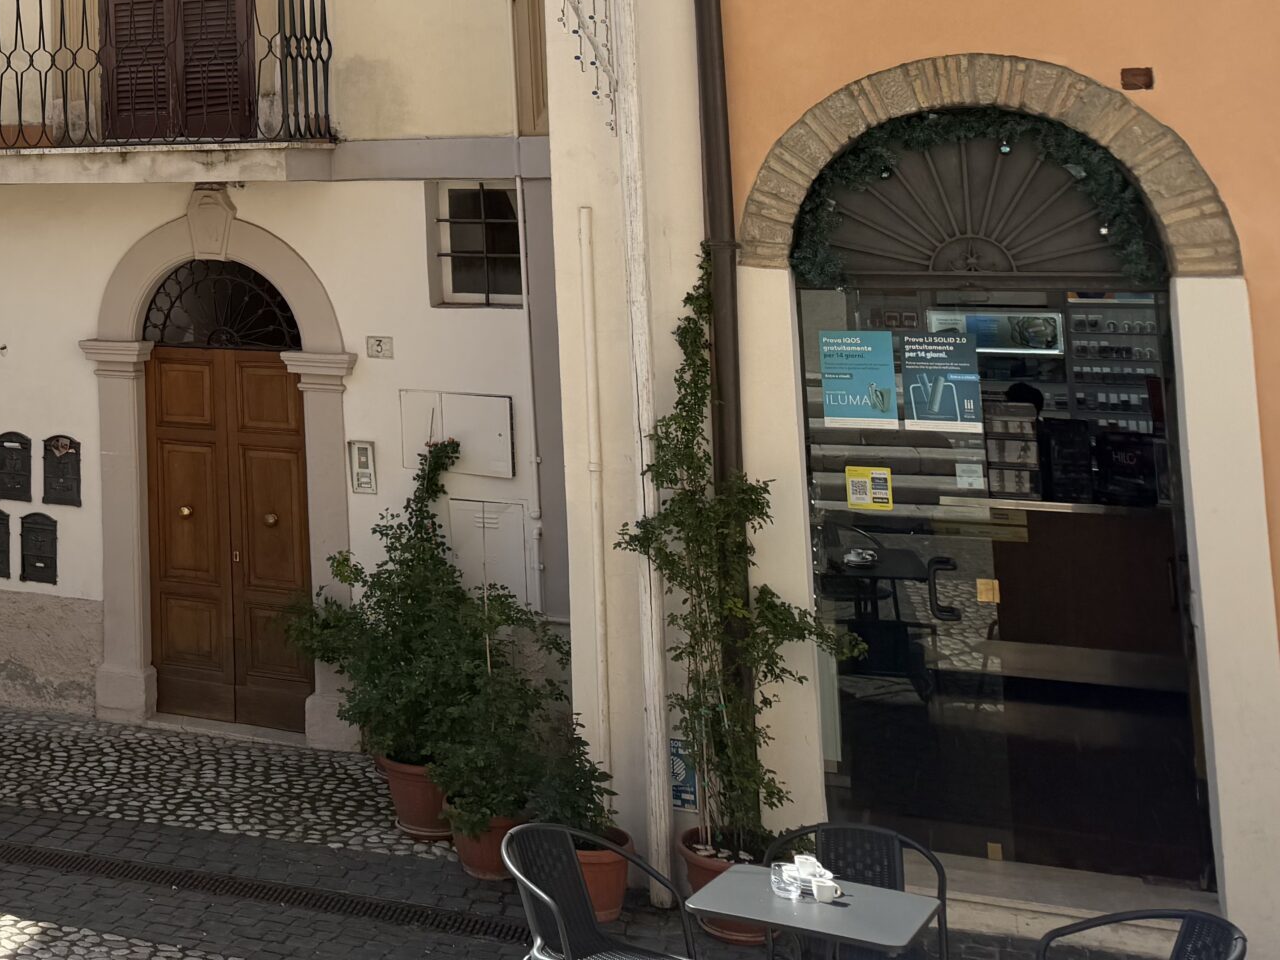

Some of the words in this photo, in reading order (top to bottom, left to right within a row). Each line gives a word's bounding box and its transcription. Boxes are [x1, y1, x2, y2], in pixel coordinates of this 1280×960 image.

[933, 336, 955, 344] SOLID
[376, 340, 382, 354] 3
[825, 394, 872, 406] ILUMA
